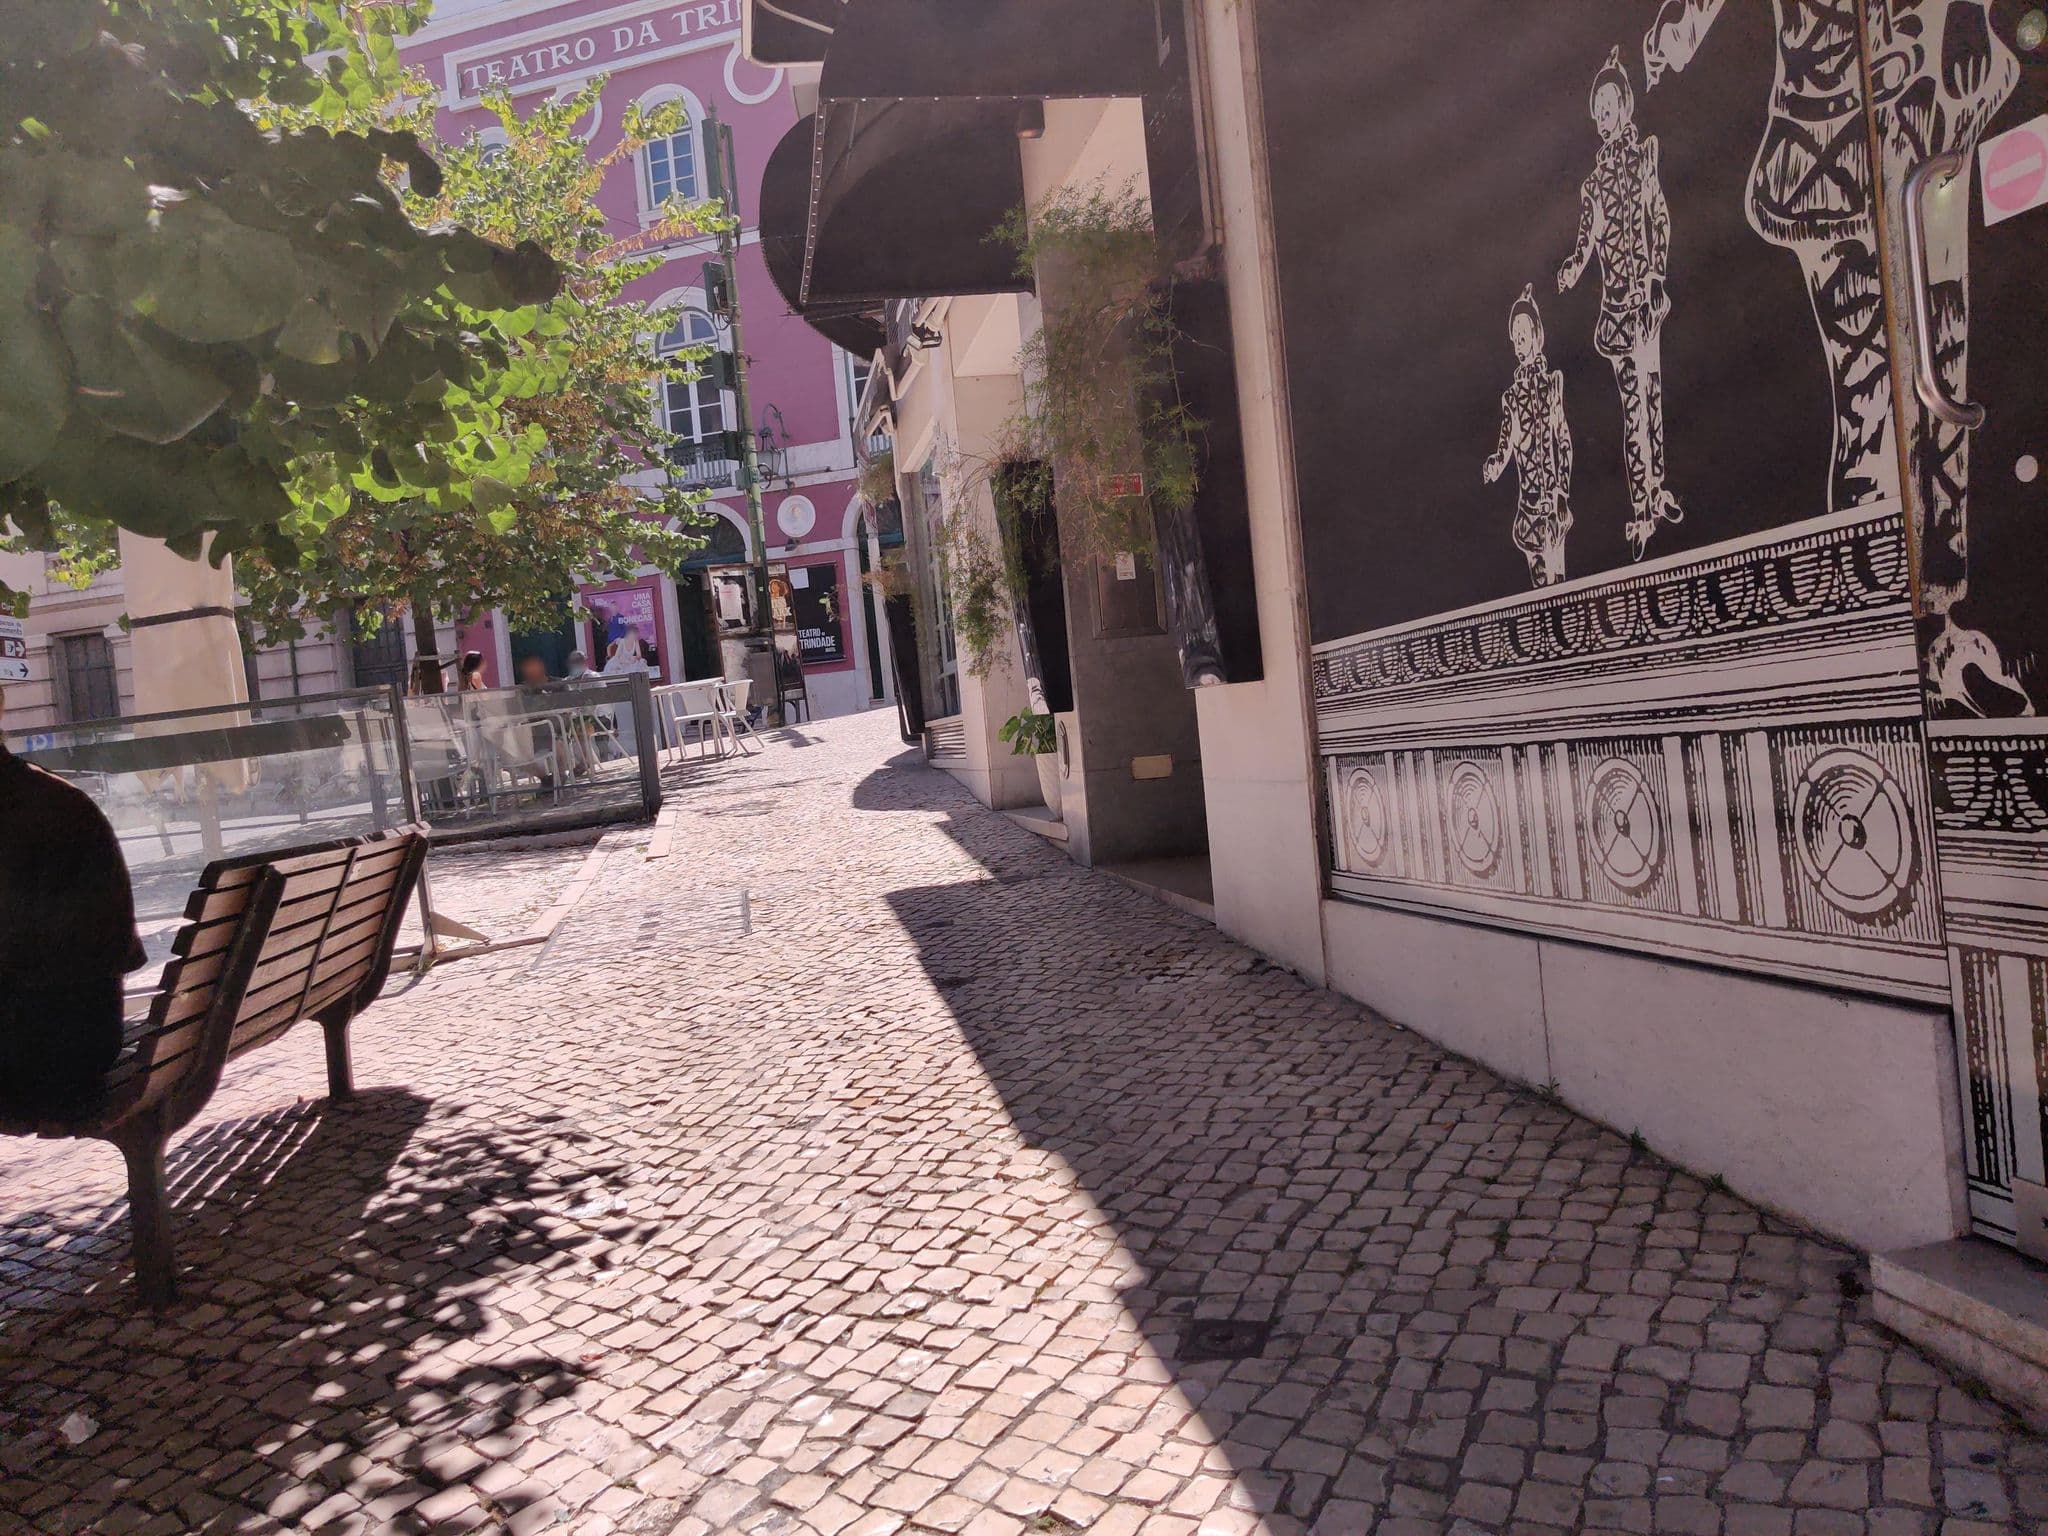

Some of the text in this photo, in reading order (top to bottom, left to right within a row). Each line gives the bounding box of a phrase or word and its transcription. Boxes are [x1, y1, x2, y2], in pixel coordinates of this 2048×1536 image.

[464, 37, 596, 90] TEATRO
[611, 19, 661, 53] DA
[633, 592, 651, 601] UMA
[631, 600, 651, 609] CASA
[798, 628, 821, 639] TEATRO
[800, 635, 836, 650] TRINDADE
